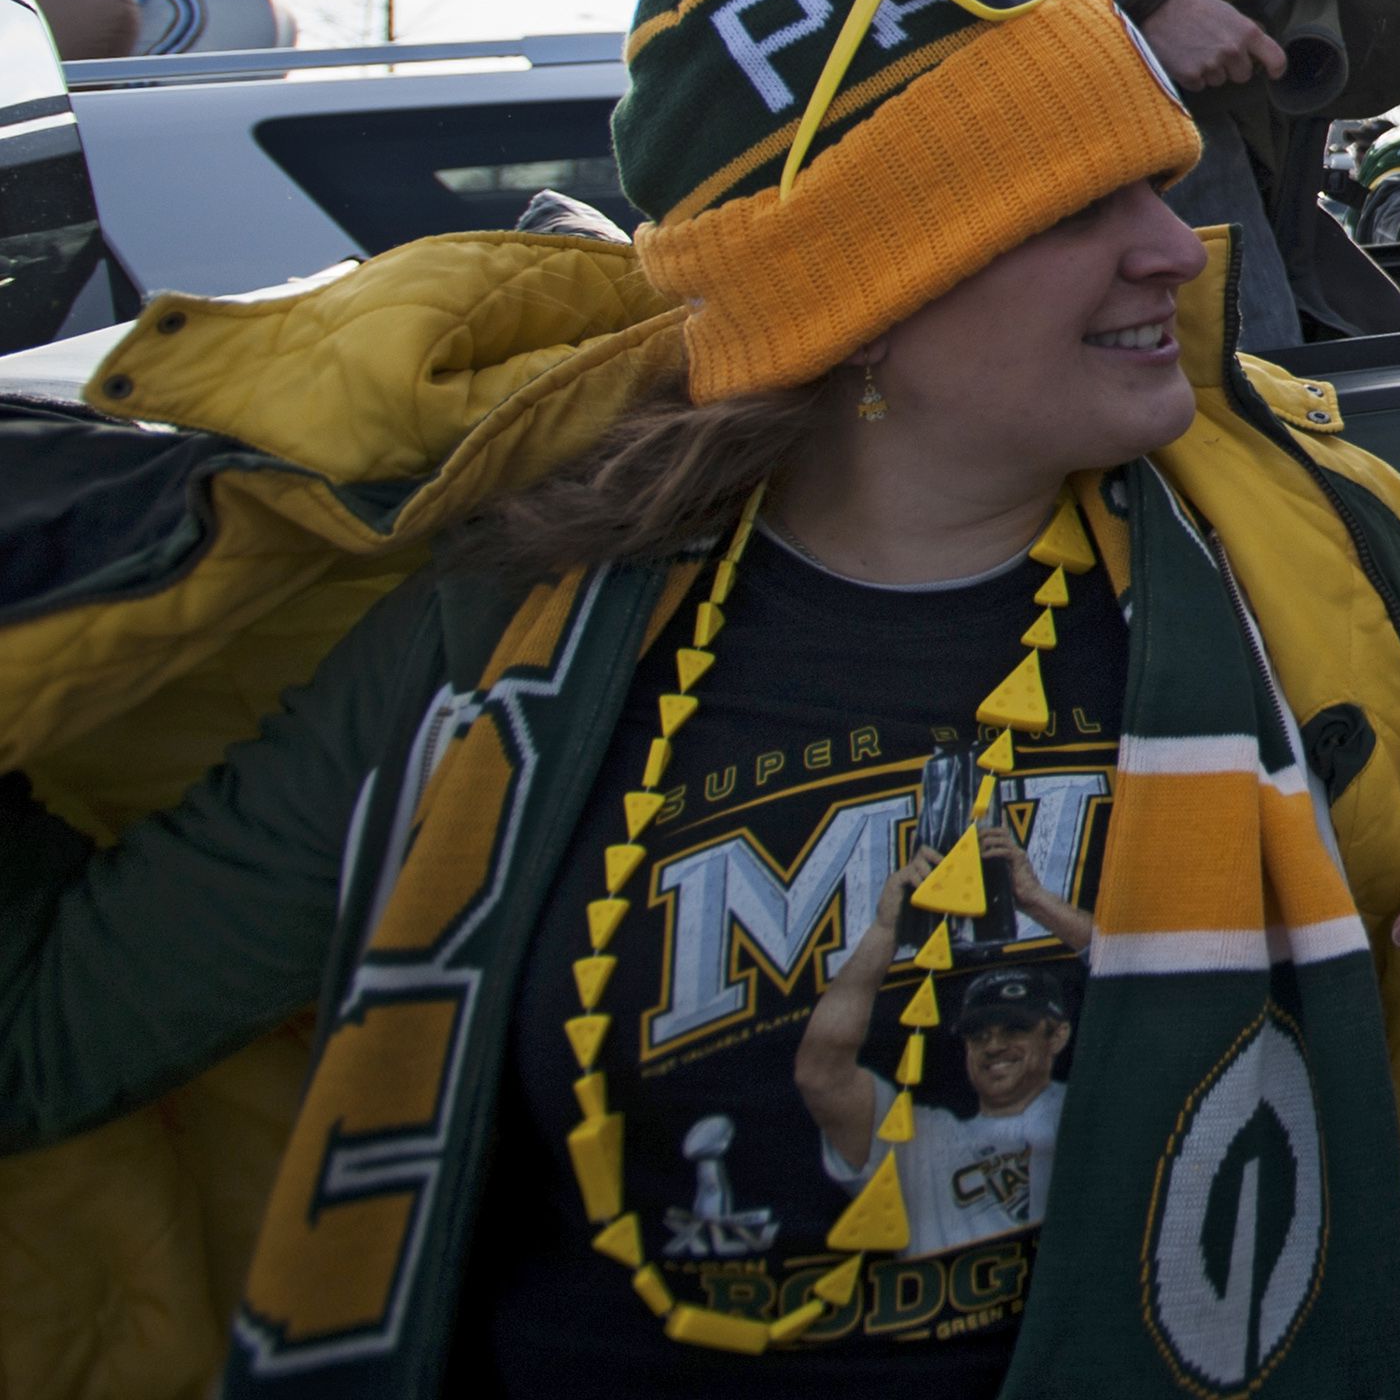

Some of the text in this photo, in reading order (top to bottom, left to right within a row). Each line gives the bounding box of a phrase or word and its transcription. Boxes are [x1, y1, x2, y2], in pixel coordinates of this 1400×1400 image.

[655, 726, 881, 826] SUPER
[661, 1220, 781, 1256] XLV
[700, 1238, 1040, 1346] RODG
